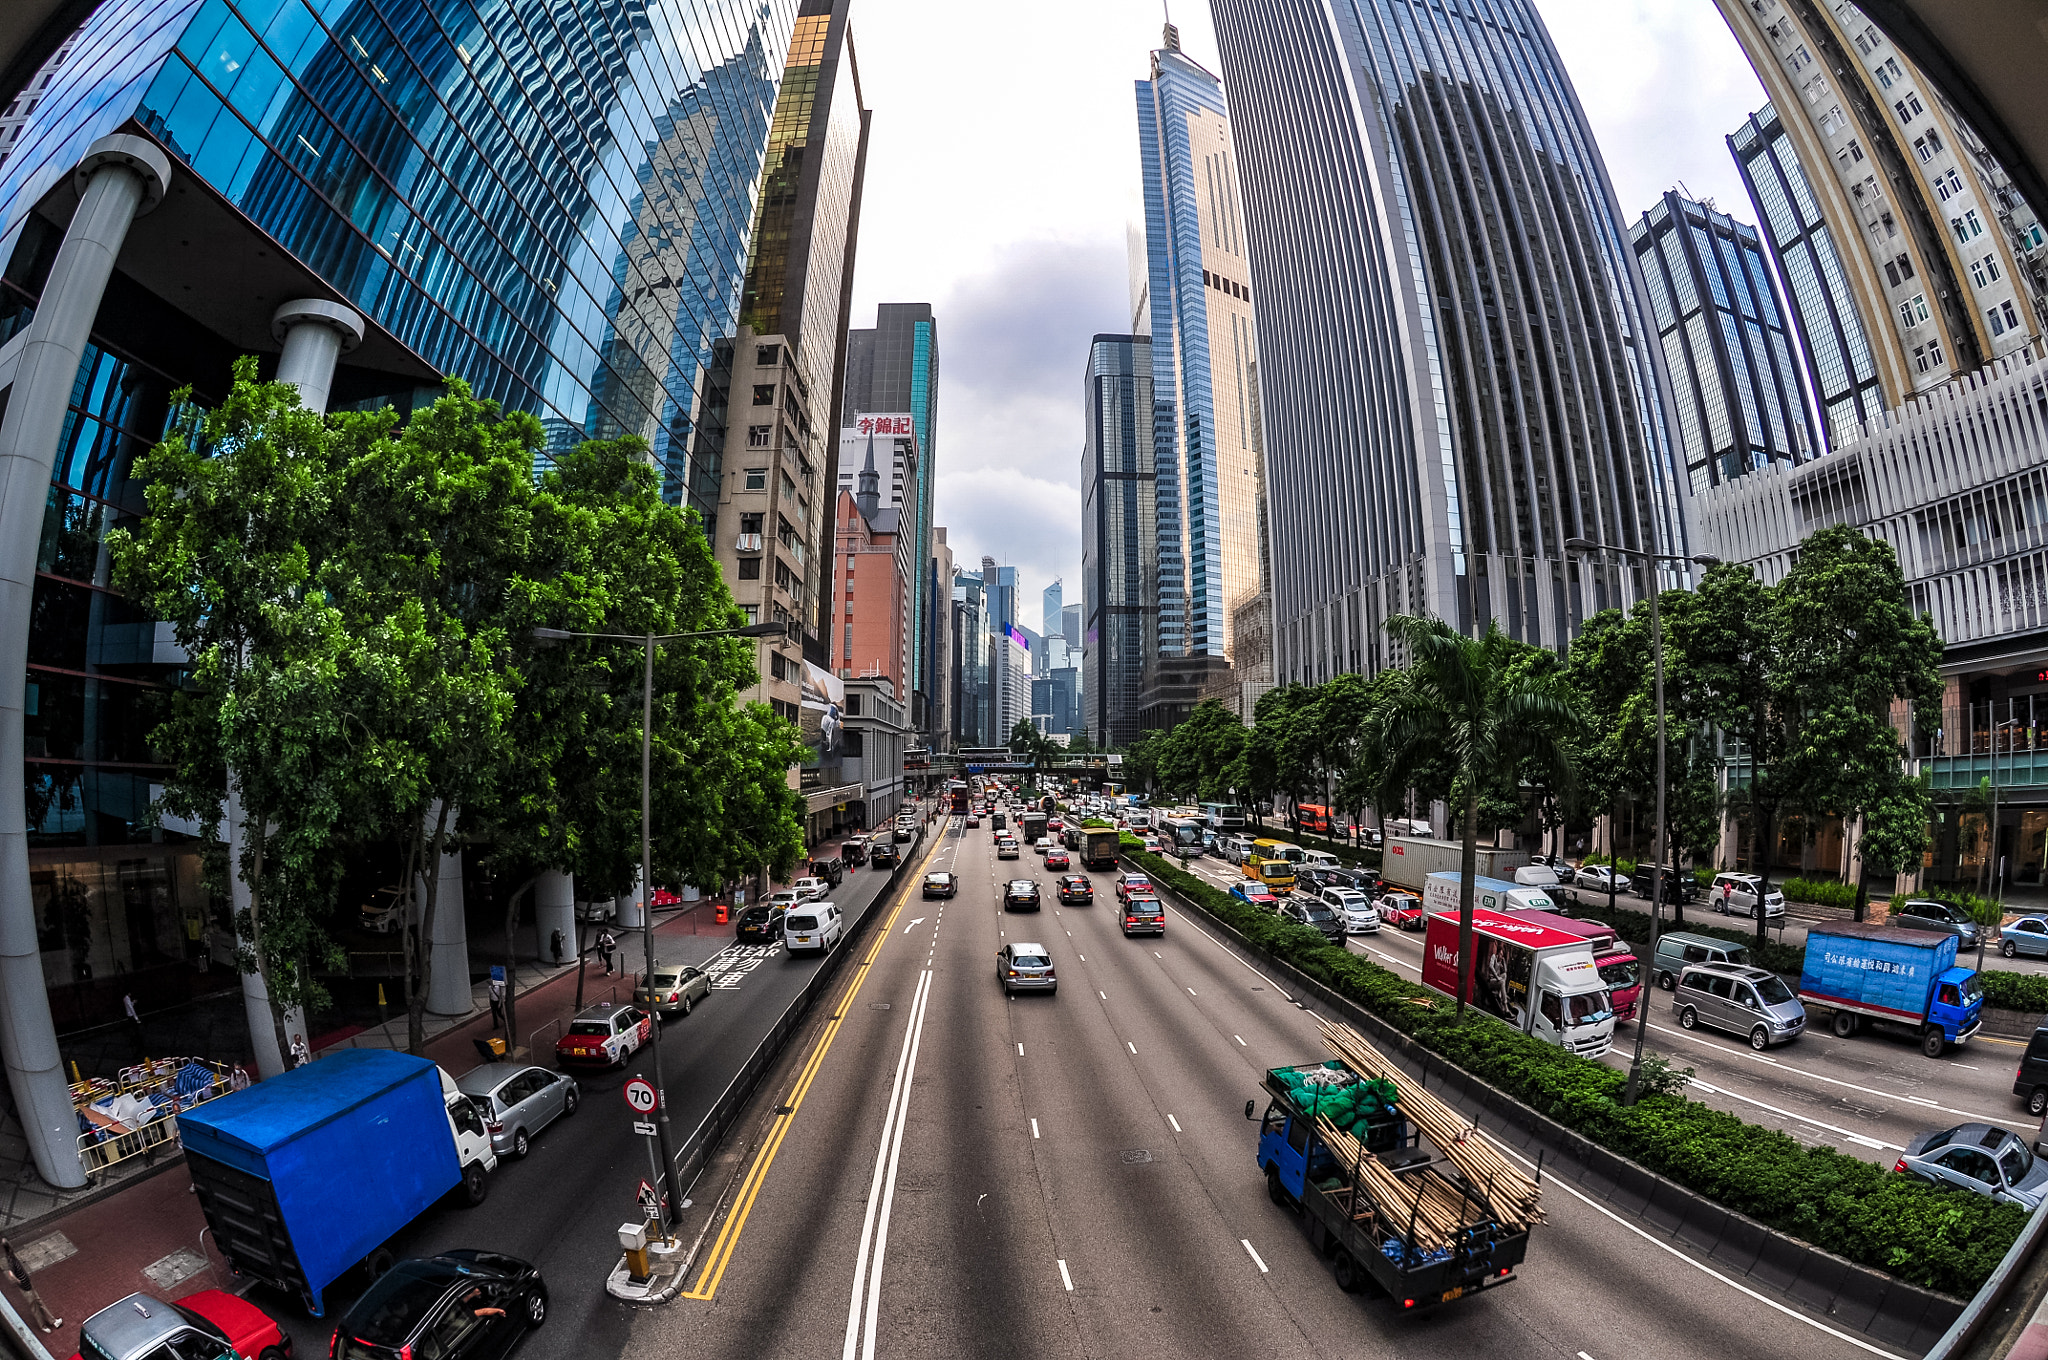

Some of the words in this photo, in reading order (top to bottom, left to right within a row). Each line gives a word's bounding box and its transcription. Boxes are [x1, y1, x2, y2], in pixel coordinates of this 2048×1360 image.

[857, 416, 911, 435] 李錦記
[720, 948, 780, 957] CLEAR
[1433, 944, 1453, 965] Walker
[630, 1089, 652, 1105] 70
